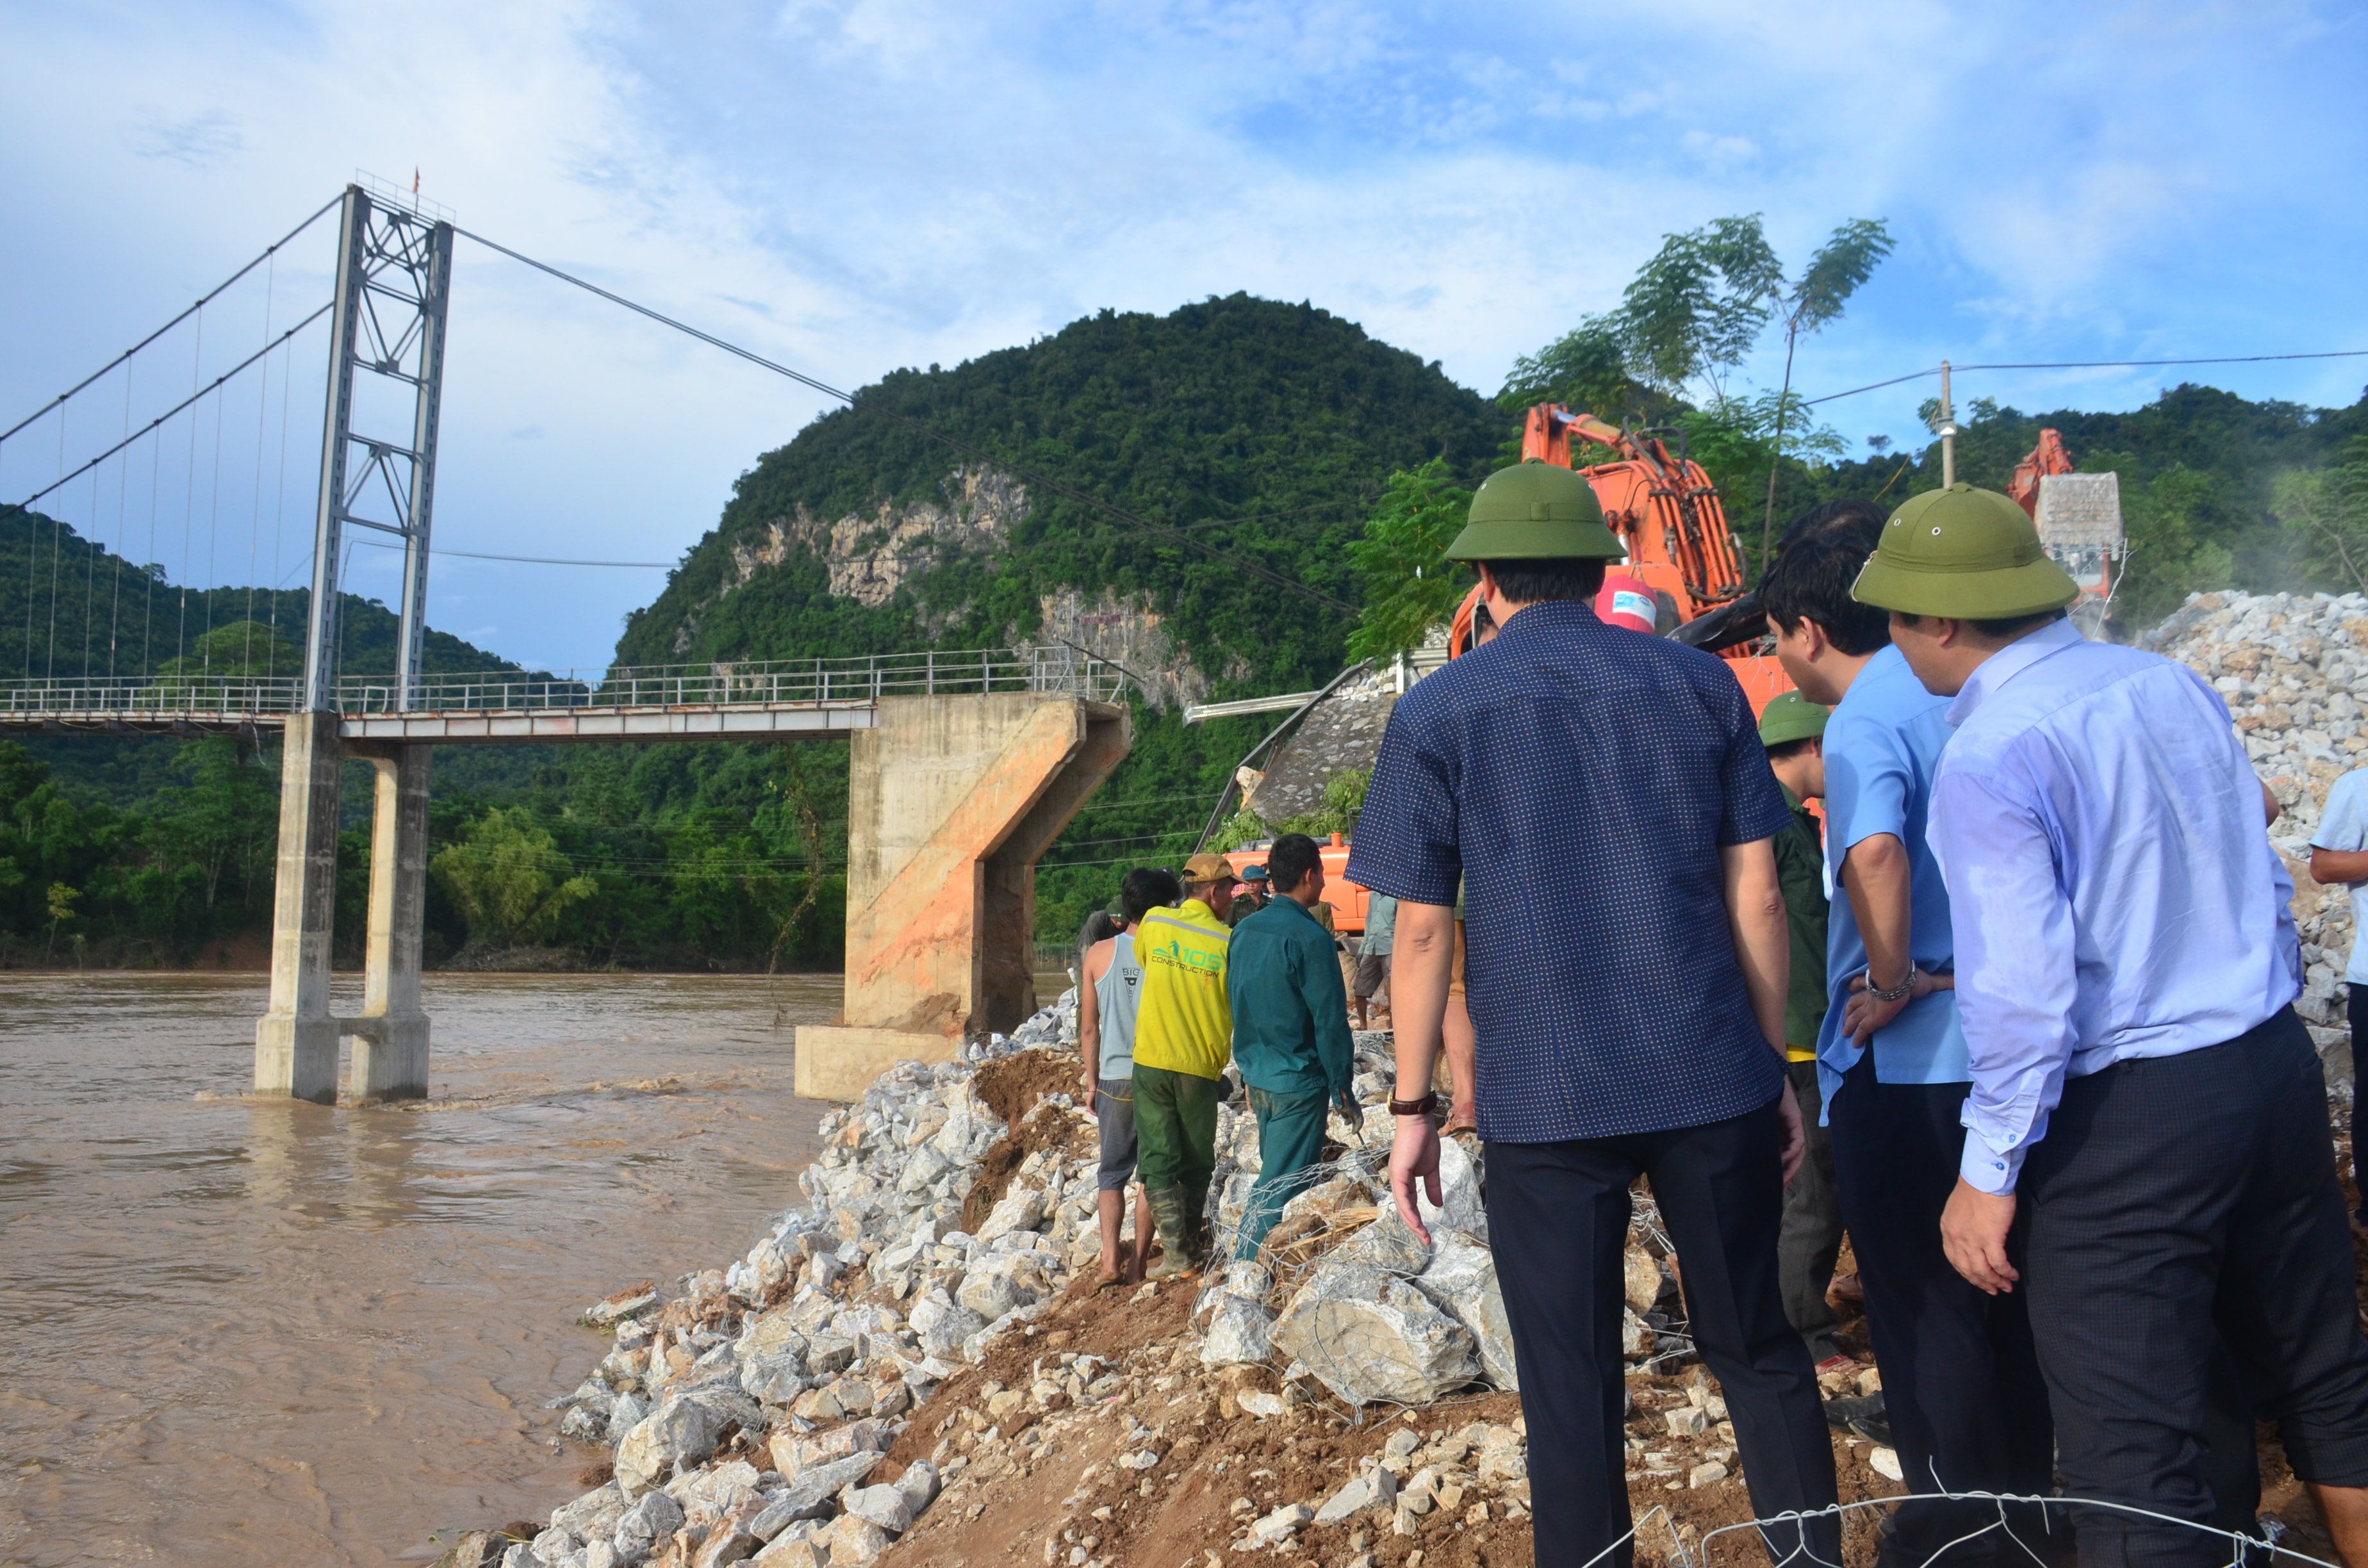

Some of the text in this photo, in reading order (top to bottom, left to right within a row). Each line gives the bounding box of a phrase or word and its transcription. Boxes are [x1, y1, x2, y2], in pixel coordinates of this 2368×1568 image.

[1152, 956, 1219, 978] CONSTRUCTION
[1183, 948, 1223, 970] 105
[1122, 968, 1140, 976] BIG
